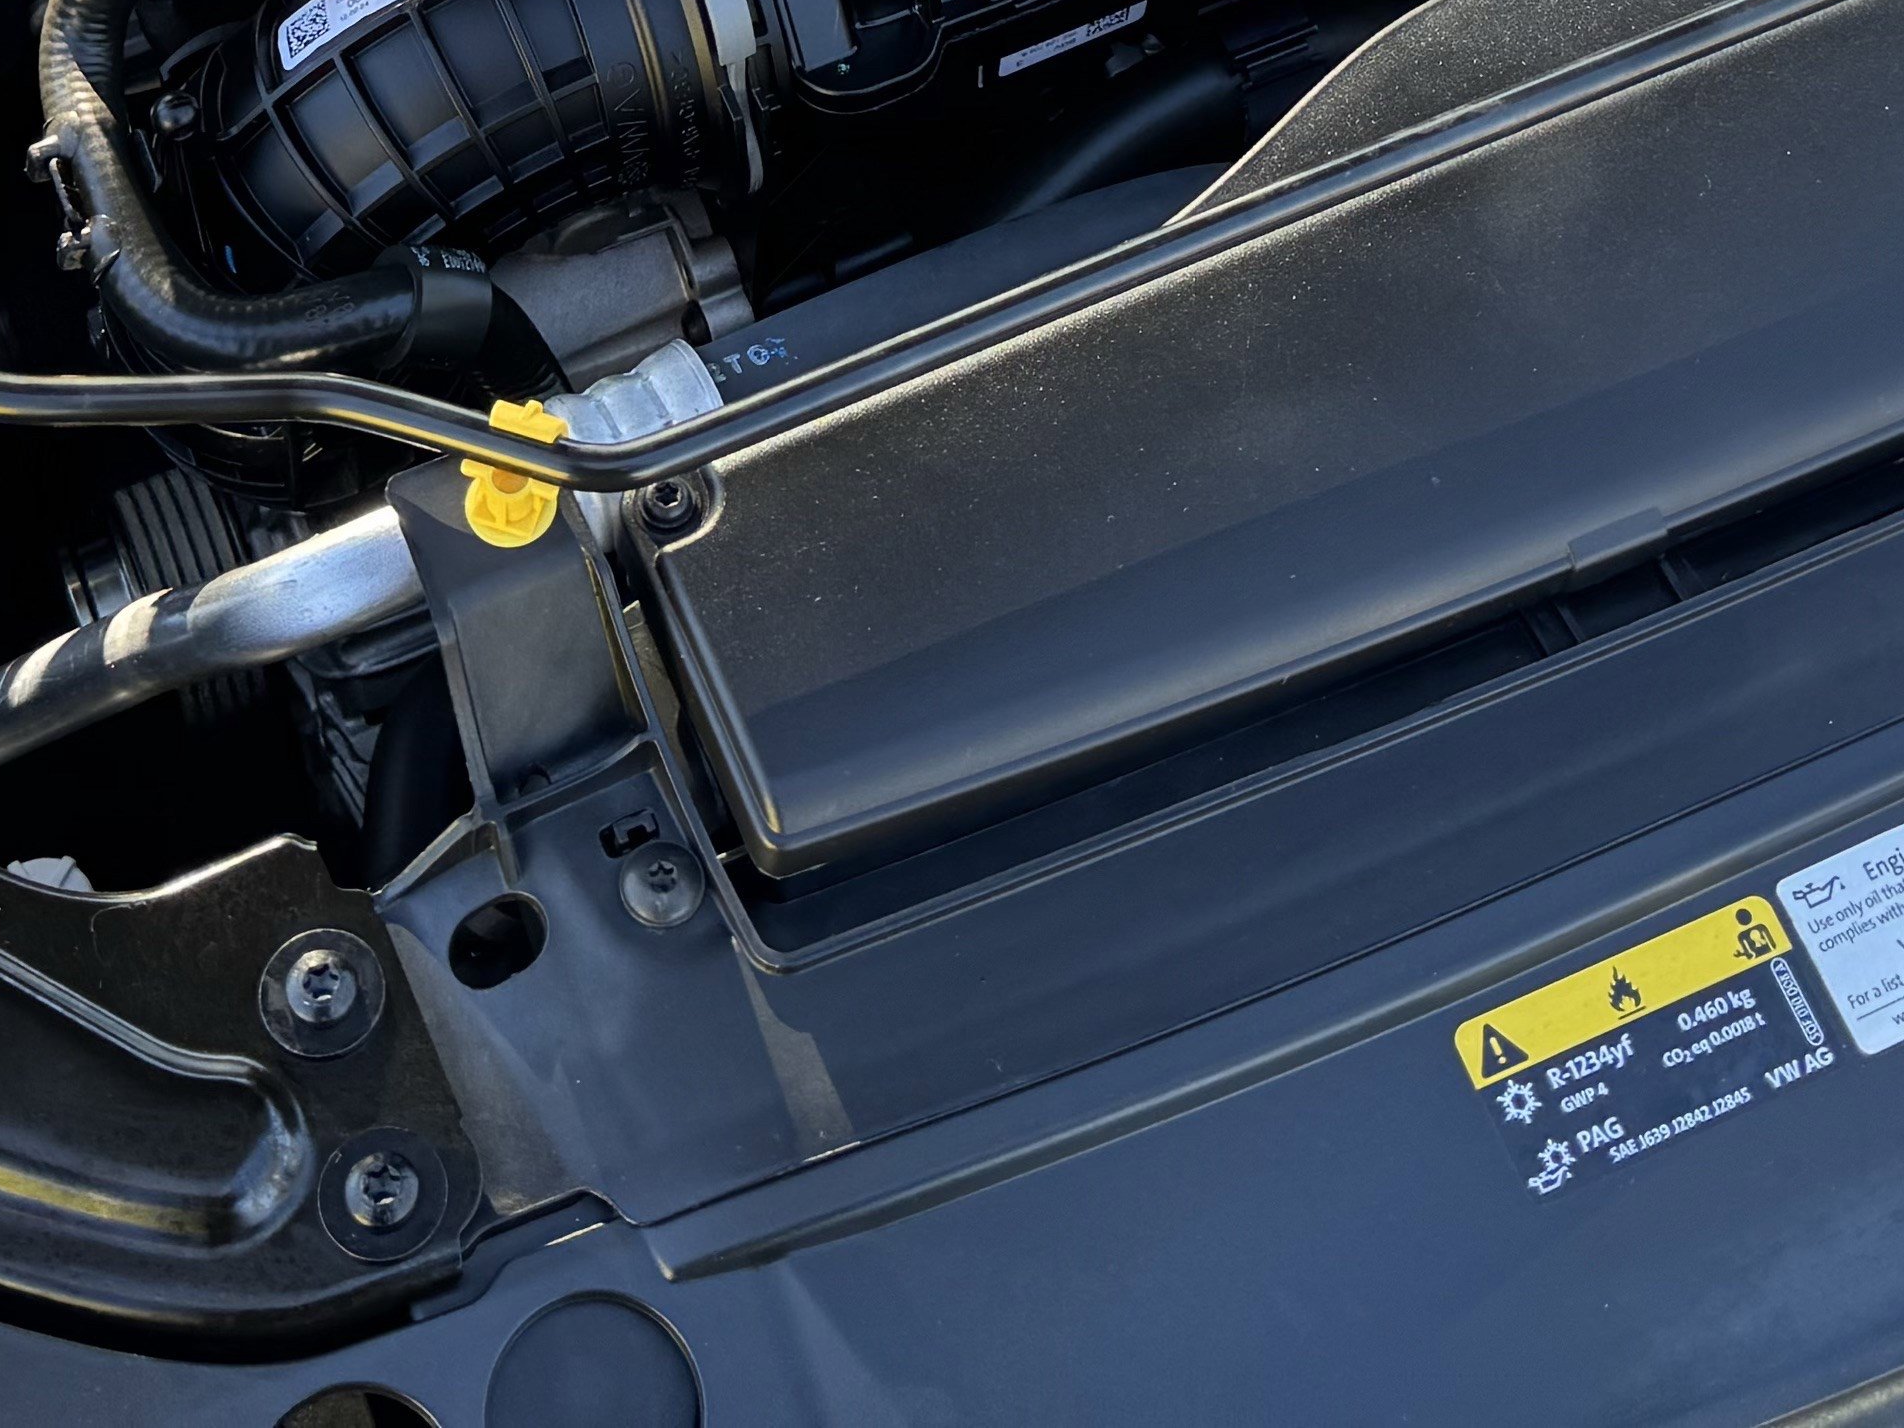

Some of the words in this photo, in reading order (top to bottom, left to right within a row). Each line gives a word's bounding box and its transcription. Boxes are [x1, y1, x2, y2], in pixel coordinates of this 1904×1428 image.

[1807, 915, 1834, 934] Use
[1834, 900, 1864, 922] only
[1864, 889, 1882, 908] oil
[1818, 918, 1877, 952] complies
[1847, 990, 1870, 1009] For
[1871, 986, 1882, 998] a
[1880, 973, 1904, 992] list
[1677, 997, 1728, 1031] 0.460
[1726, 988, 1756, 1009] kg
[1546, 1032, 1634, 1089] R-1234yf
[1691, 1038, 1713, 1054] eq
[1764, 1059, 1801, 1088] VW
[1804, 1046, 1834, 1074] AG
[1560, 1087, 1595, 1113] GWP
[1597, 1081, 1609, 1095] 4
[1576, 1116, 1624, 1153] PAG
[1608, 1138, 1639, 1163] SAE
